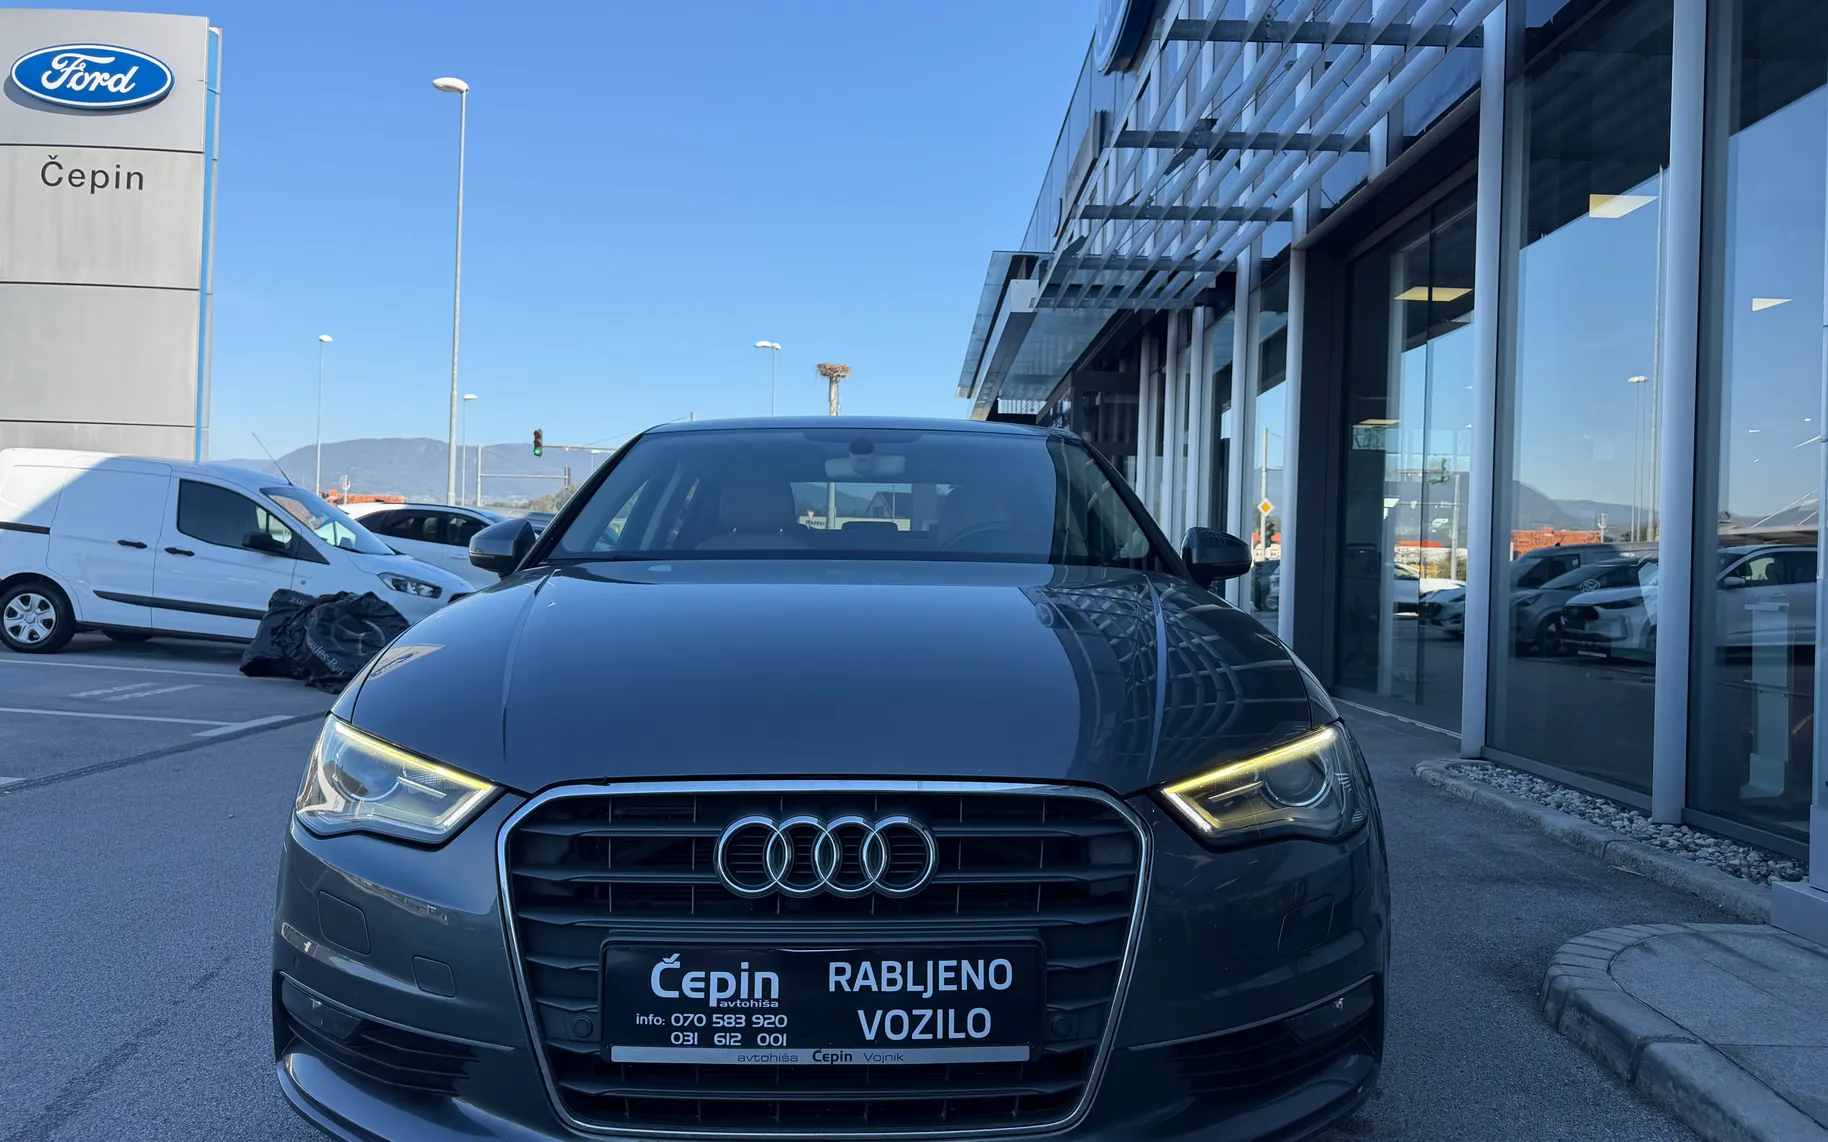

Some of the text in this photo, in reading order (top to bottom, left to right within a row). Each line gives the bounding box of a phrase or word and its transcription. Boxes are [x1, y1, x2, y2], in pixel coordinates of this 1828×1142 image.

[41, 53, 139, 93] Ford
[41, 154, 144, 194] Čepin
[650, 953, 779, 1007] Čepin
[828, 958, 1013, 998] RABLJENO
[636, 1013, 788, 1028] info: 070 583 920
[719, 999, 779, 1008] avtohiša
[670, 1031, 787, 1047] 031 612 001
[857, 1007, 992, 1041] VOZILO
[737, 1048, 905, 1065] avtohiša Čepin Vojnik
